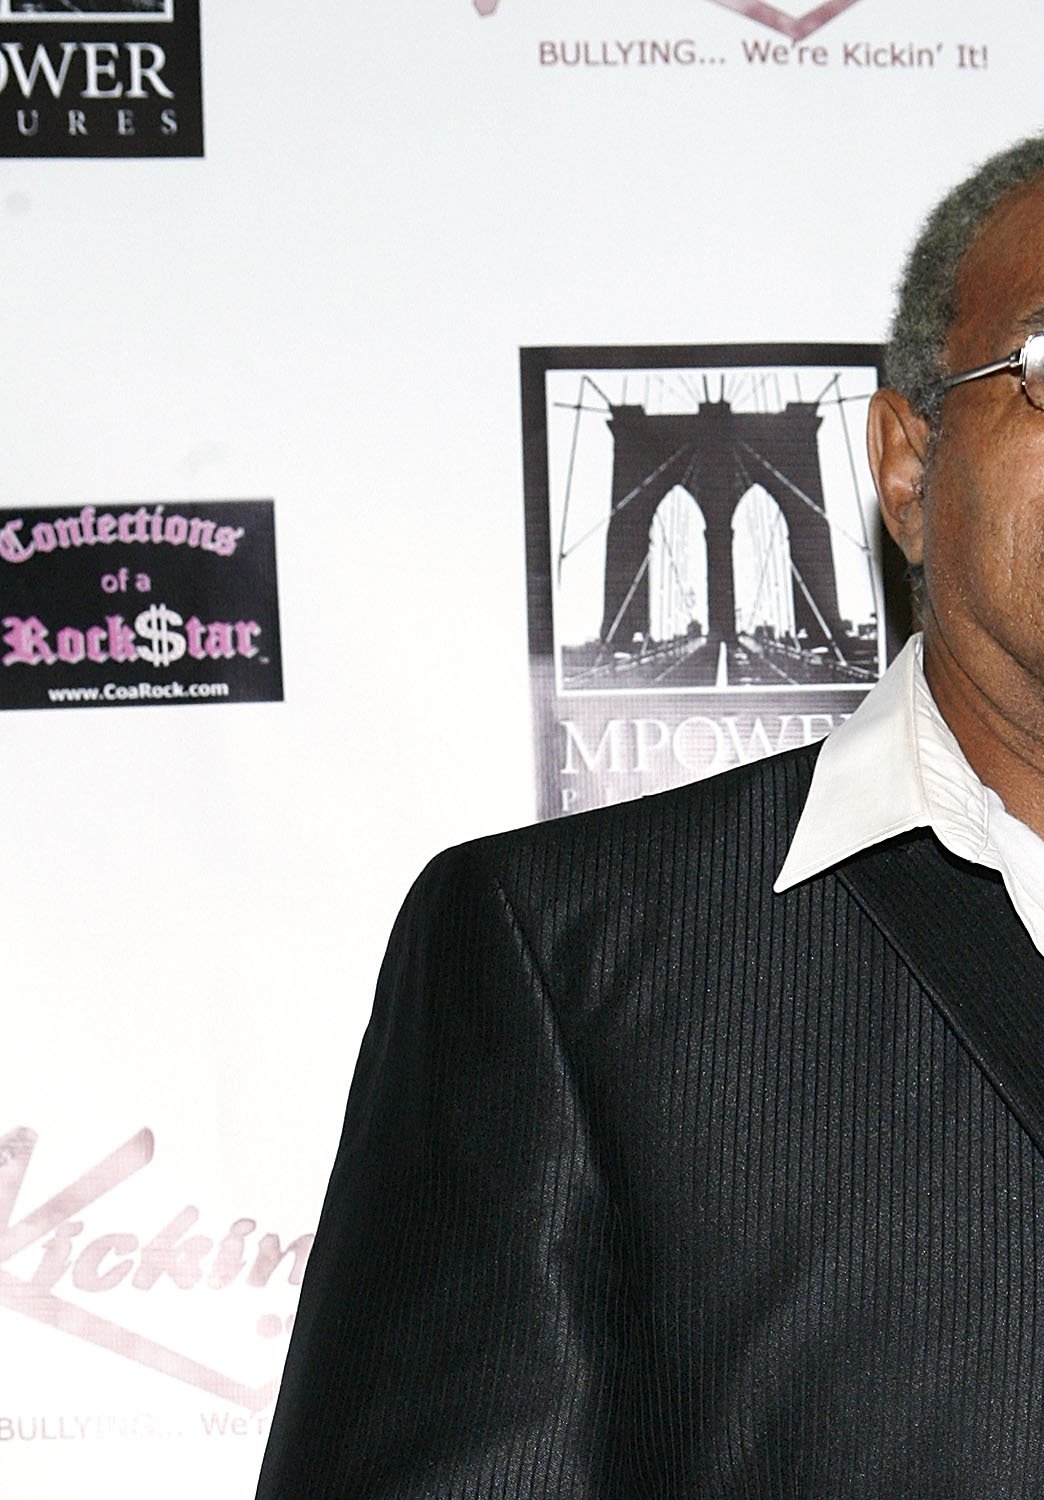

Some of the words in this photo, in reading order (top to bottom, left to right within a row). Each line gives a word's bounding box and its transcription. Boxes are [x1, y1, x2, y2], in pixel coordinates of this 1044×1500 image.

[538, 40, 726, 66] BULLYING...
[742, 38, 829, 65] We're
[843, 42, 943, 68] Kickin'
[957, 44, 989, 69] It!
[0, 42, 175, 99] WER
[0, 505, 245, 563] Confections
[101, 567, 129, 593] of
[135, 572, 151, 592] a
[48, 682, 229, 702] www.CoaRock.com
